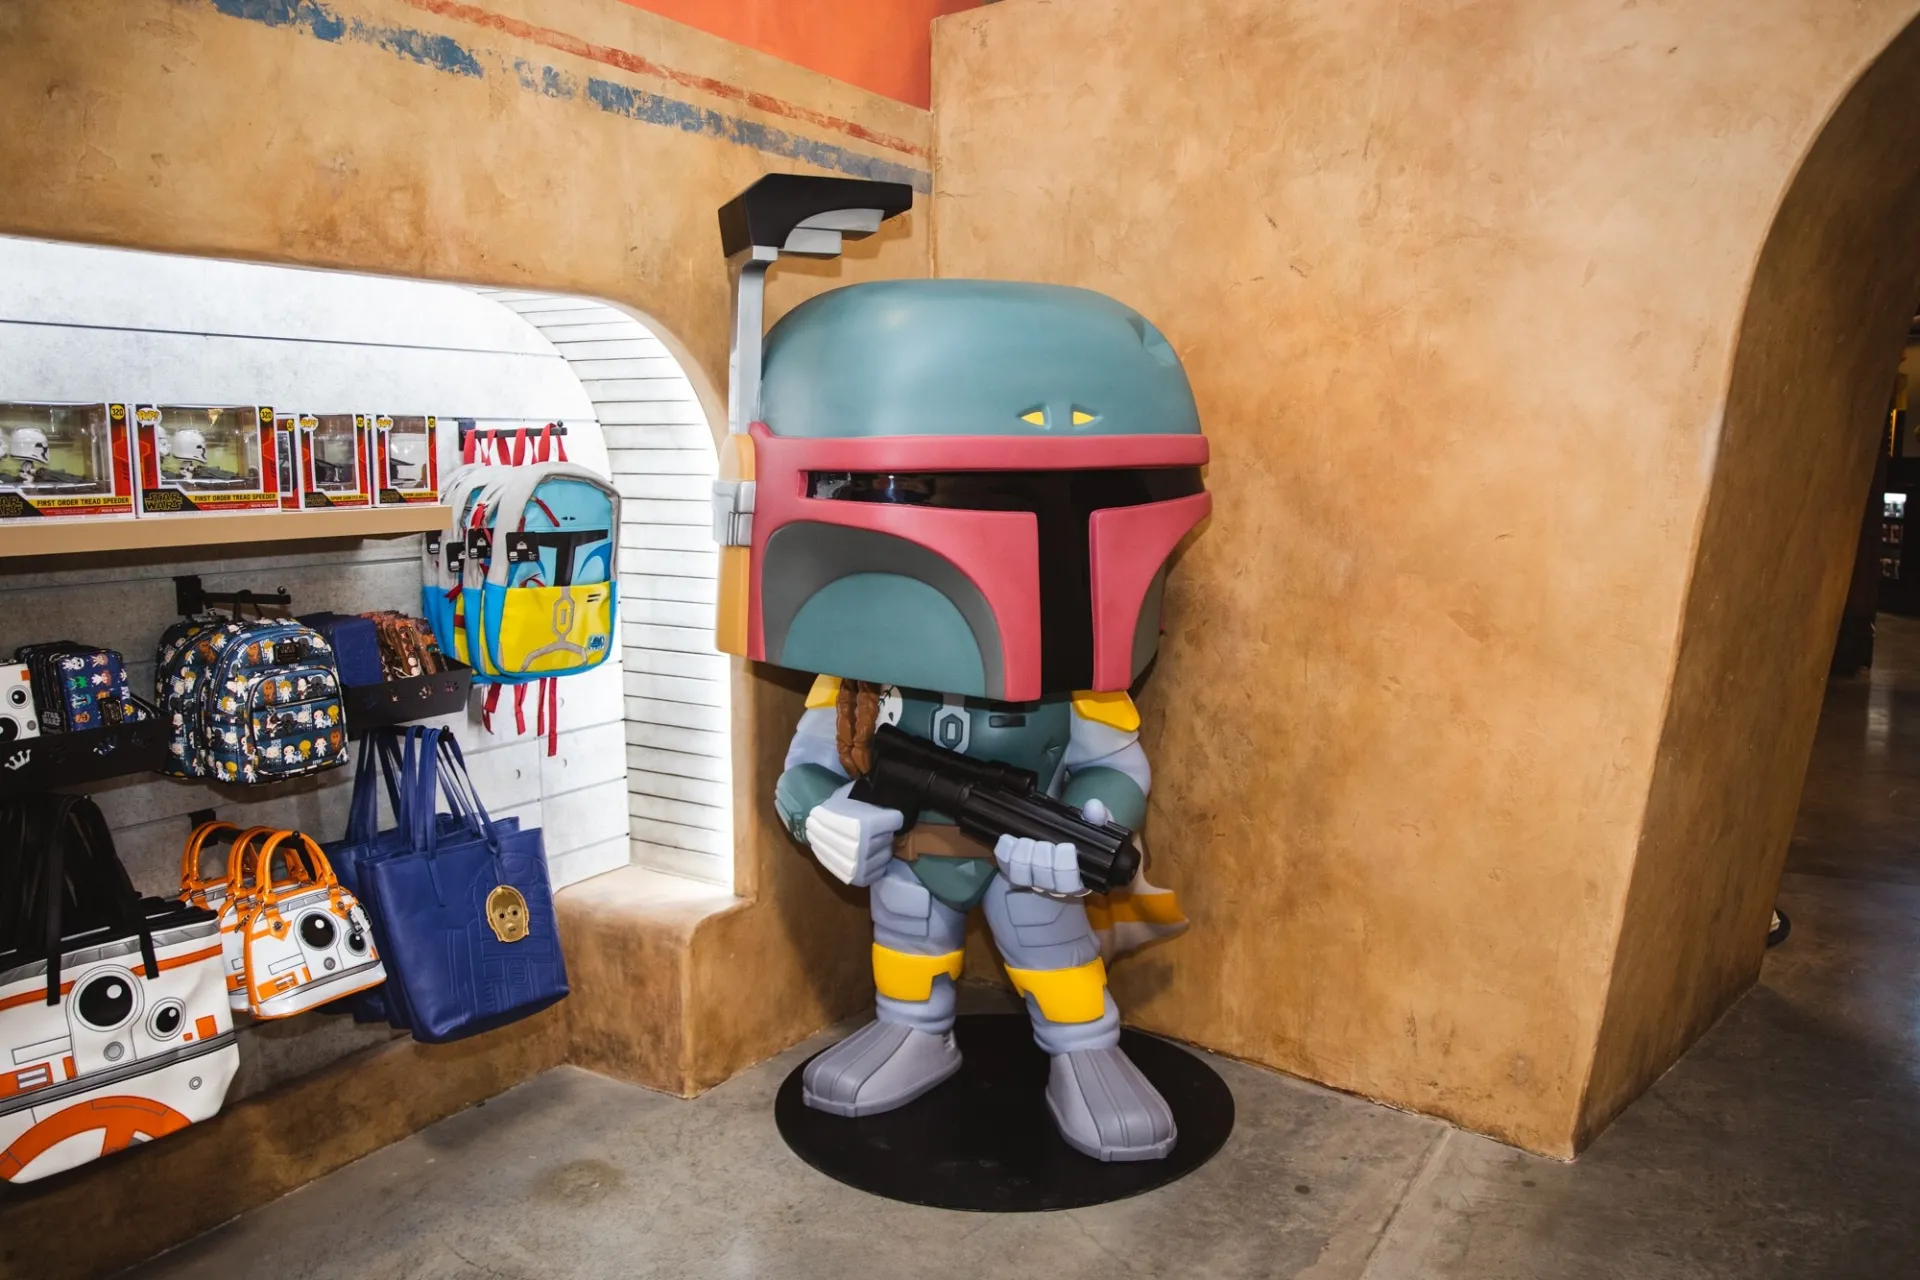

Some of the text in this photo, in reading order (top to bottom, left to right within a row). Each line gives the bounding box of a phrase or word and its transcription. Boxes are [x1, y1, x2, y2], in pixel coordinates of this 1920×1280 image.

[112, 408, 124, 417] 320
[261, 410, 273, 419] 320
[144, 492, 182, 501] STAR
[37, 499, 55, 507] FIRST
[145, 500, 182, 511] WARS
[42, 711, 60, 719] STAR
[42, 717, 61, 726] WARS
